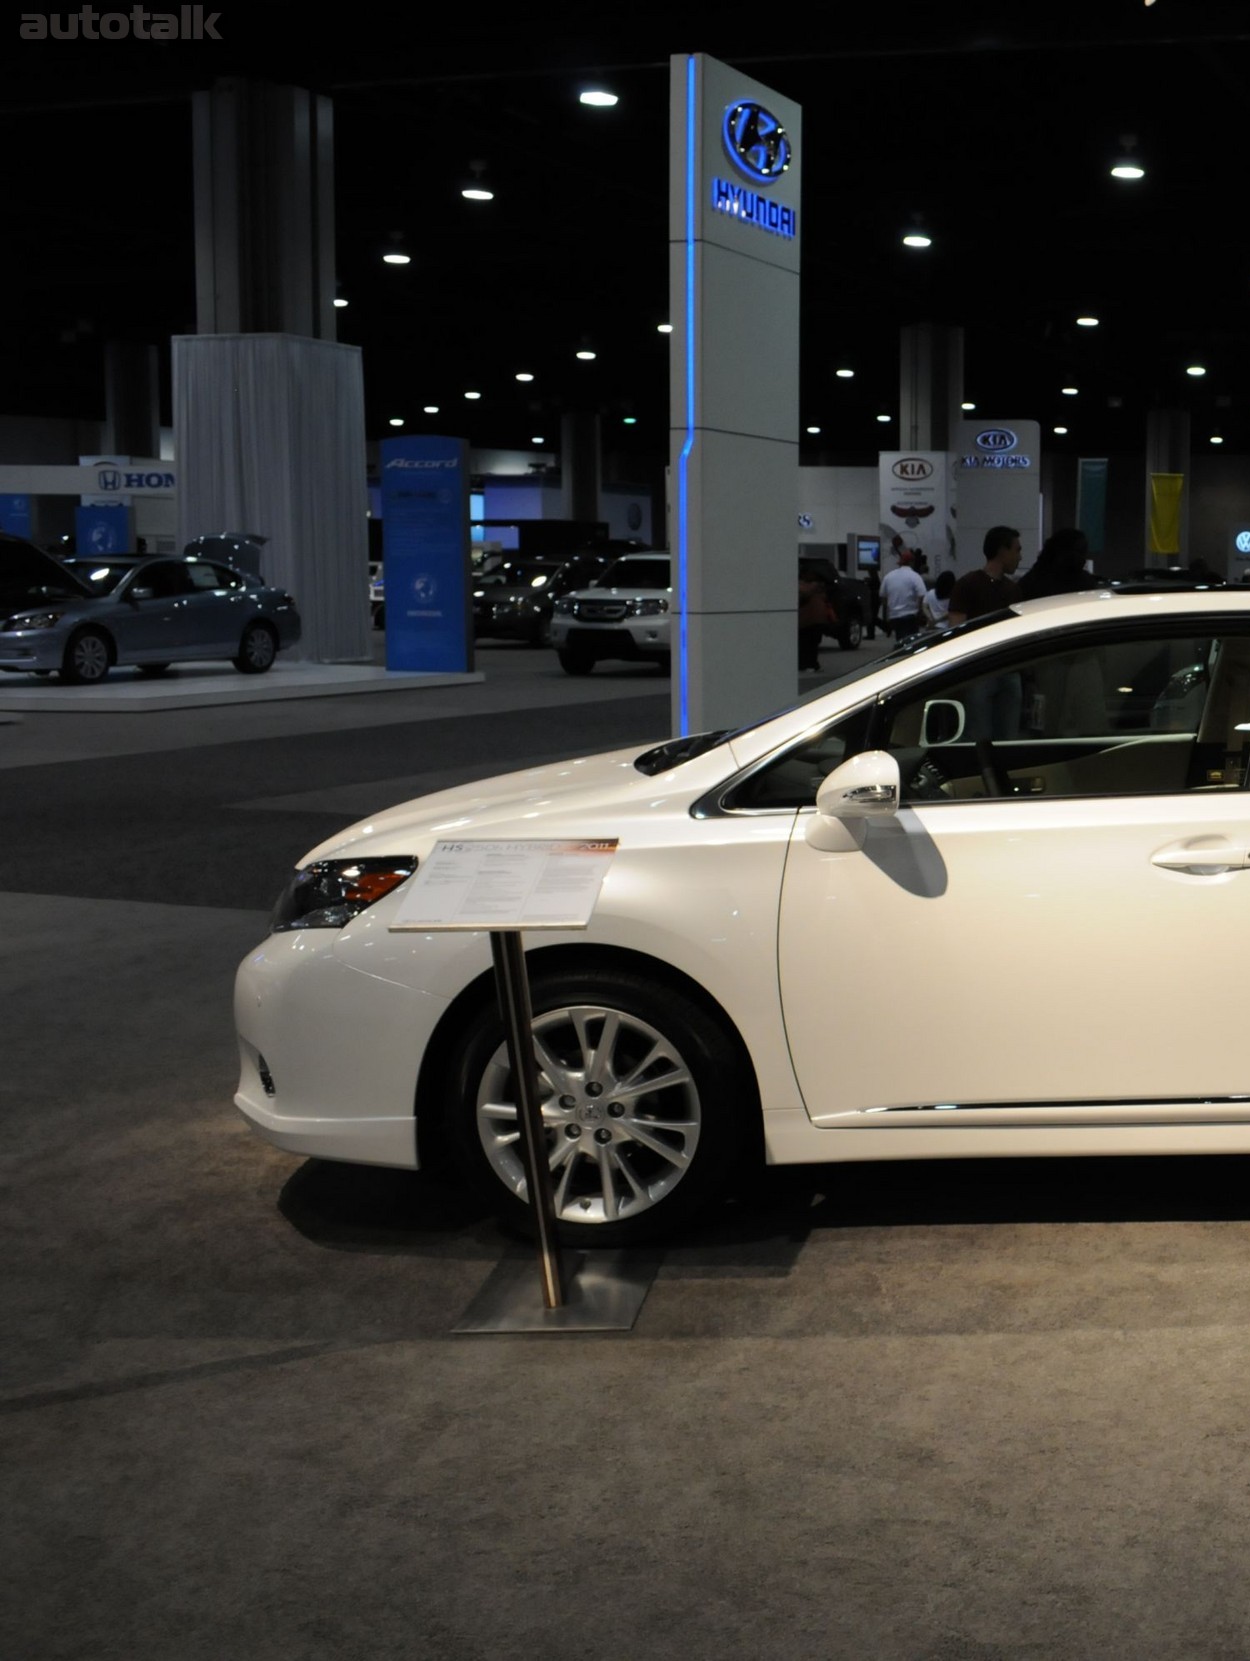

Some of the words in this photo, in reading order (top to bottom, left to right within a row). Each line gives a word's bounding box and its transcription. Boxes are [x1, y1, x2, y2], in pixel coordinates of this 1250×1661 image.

[713, 178, 796, 237] HYUNDAI
[982, 434, 1009, 446] KIA
[386, 457, 458, 469] Accord
[961, 455, 980, 468] KIA
[982, 455, 1031, 468] MOTORS
[900, 463, 926, 476] KIA
